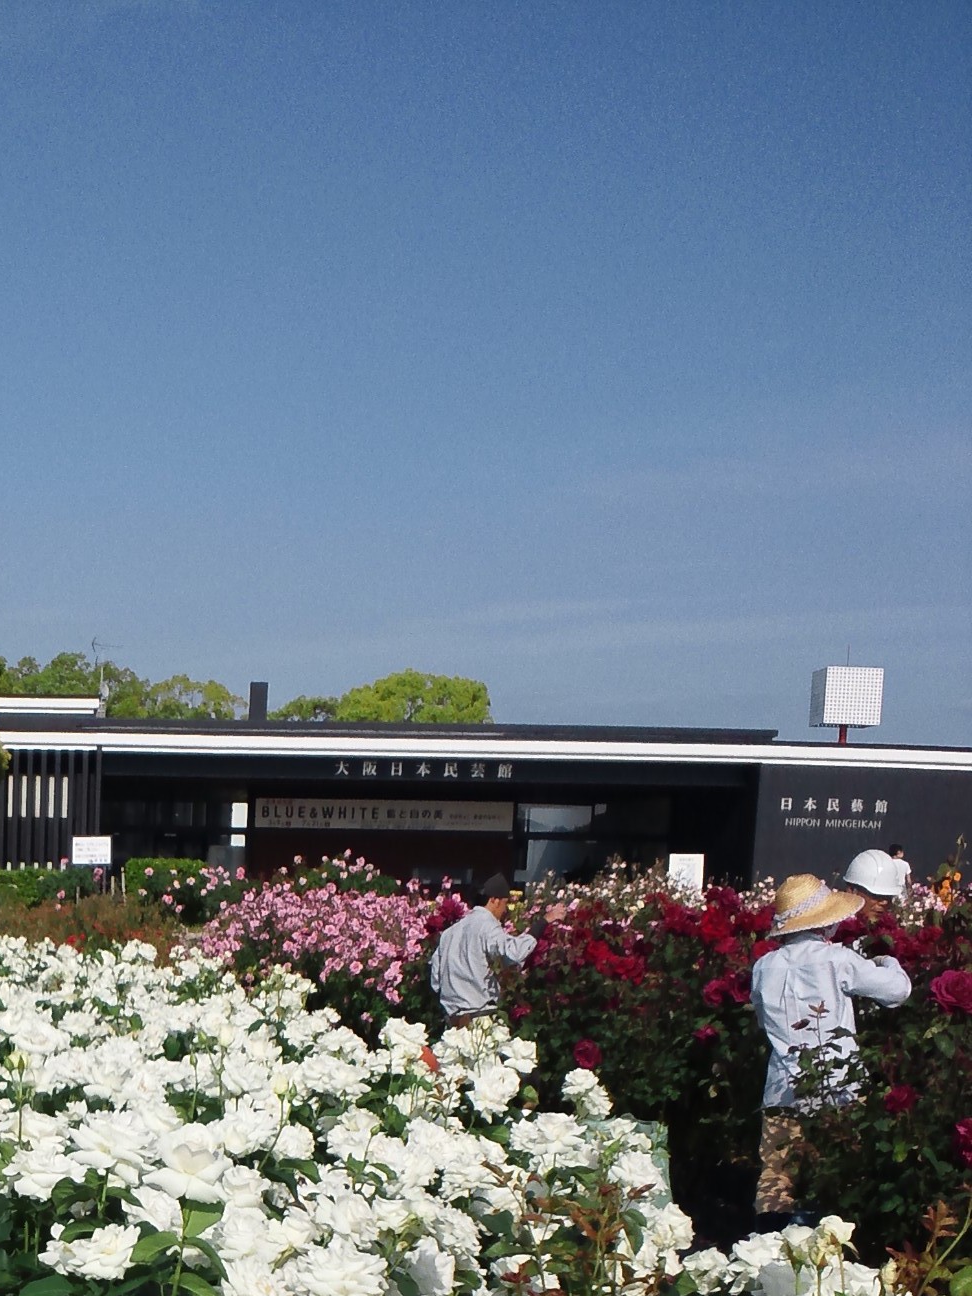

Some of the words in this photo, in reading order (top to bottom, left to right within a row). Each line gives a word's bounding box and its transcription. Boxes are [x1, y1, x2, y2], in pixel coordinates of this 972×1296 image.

[335, 761, 513, 779] 大阪日本民芸館
[780, 797, 888, 814] 日本民藝館
[785, 818, 821, 828] NIPPON
[825, 819, 882, 830] MINGEIKAN
